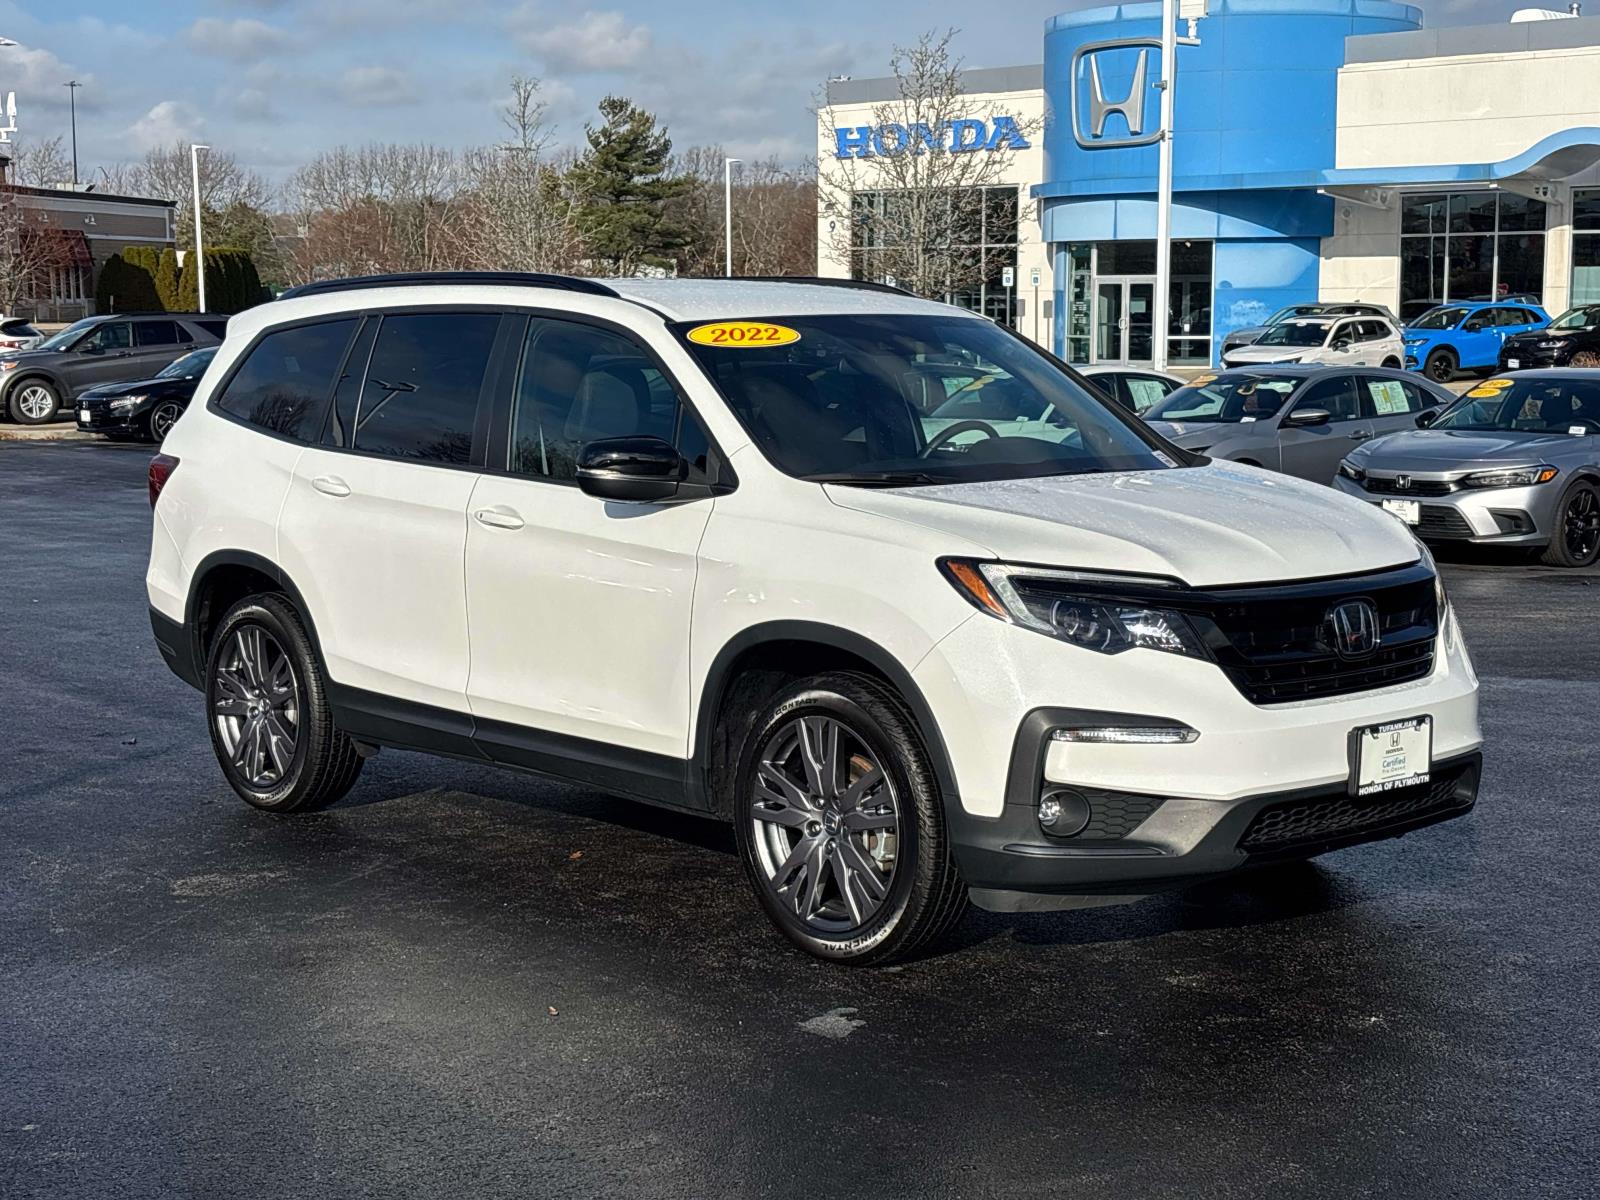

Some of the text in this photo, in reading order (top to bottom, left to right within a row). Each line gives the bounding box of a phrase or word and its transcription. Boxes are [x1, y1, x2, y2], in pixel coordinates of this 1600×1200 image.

[835, 116, 1032, 160] HONDA
[710, 327, 781, 343] 2022
[1378, 720, 1417, 733] TUFANKJIAN
[1382, 756, 1406, 769] Certified
[1358, 774, 1430, 796] HONDA OF PLYMOUTH
